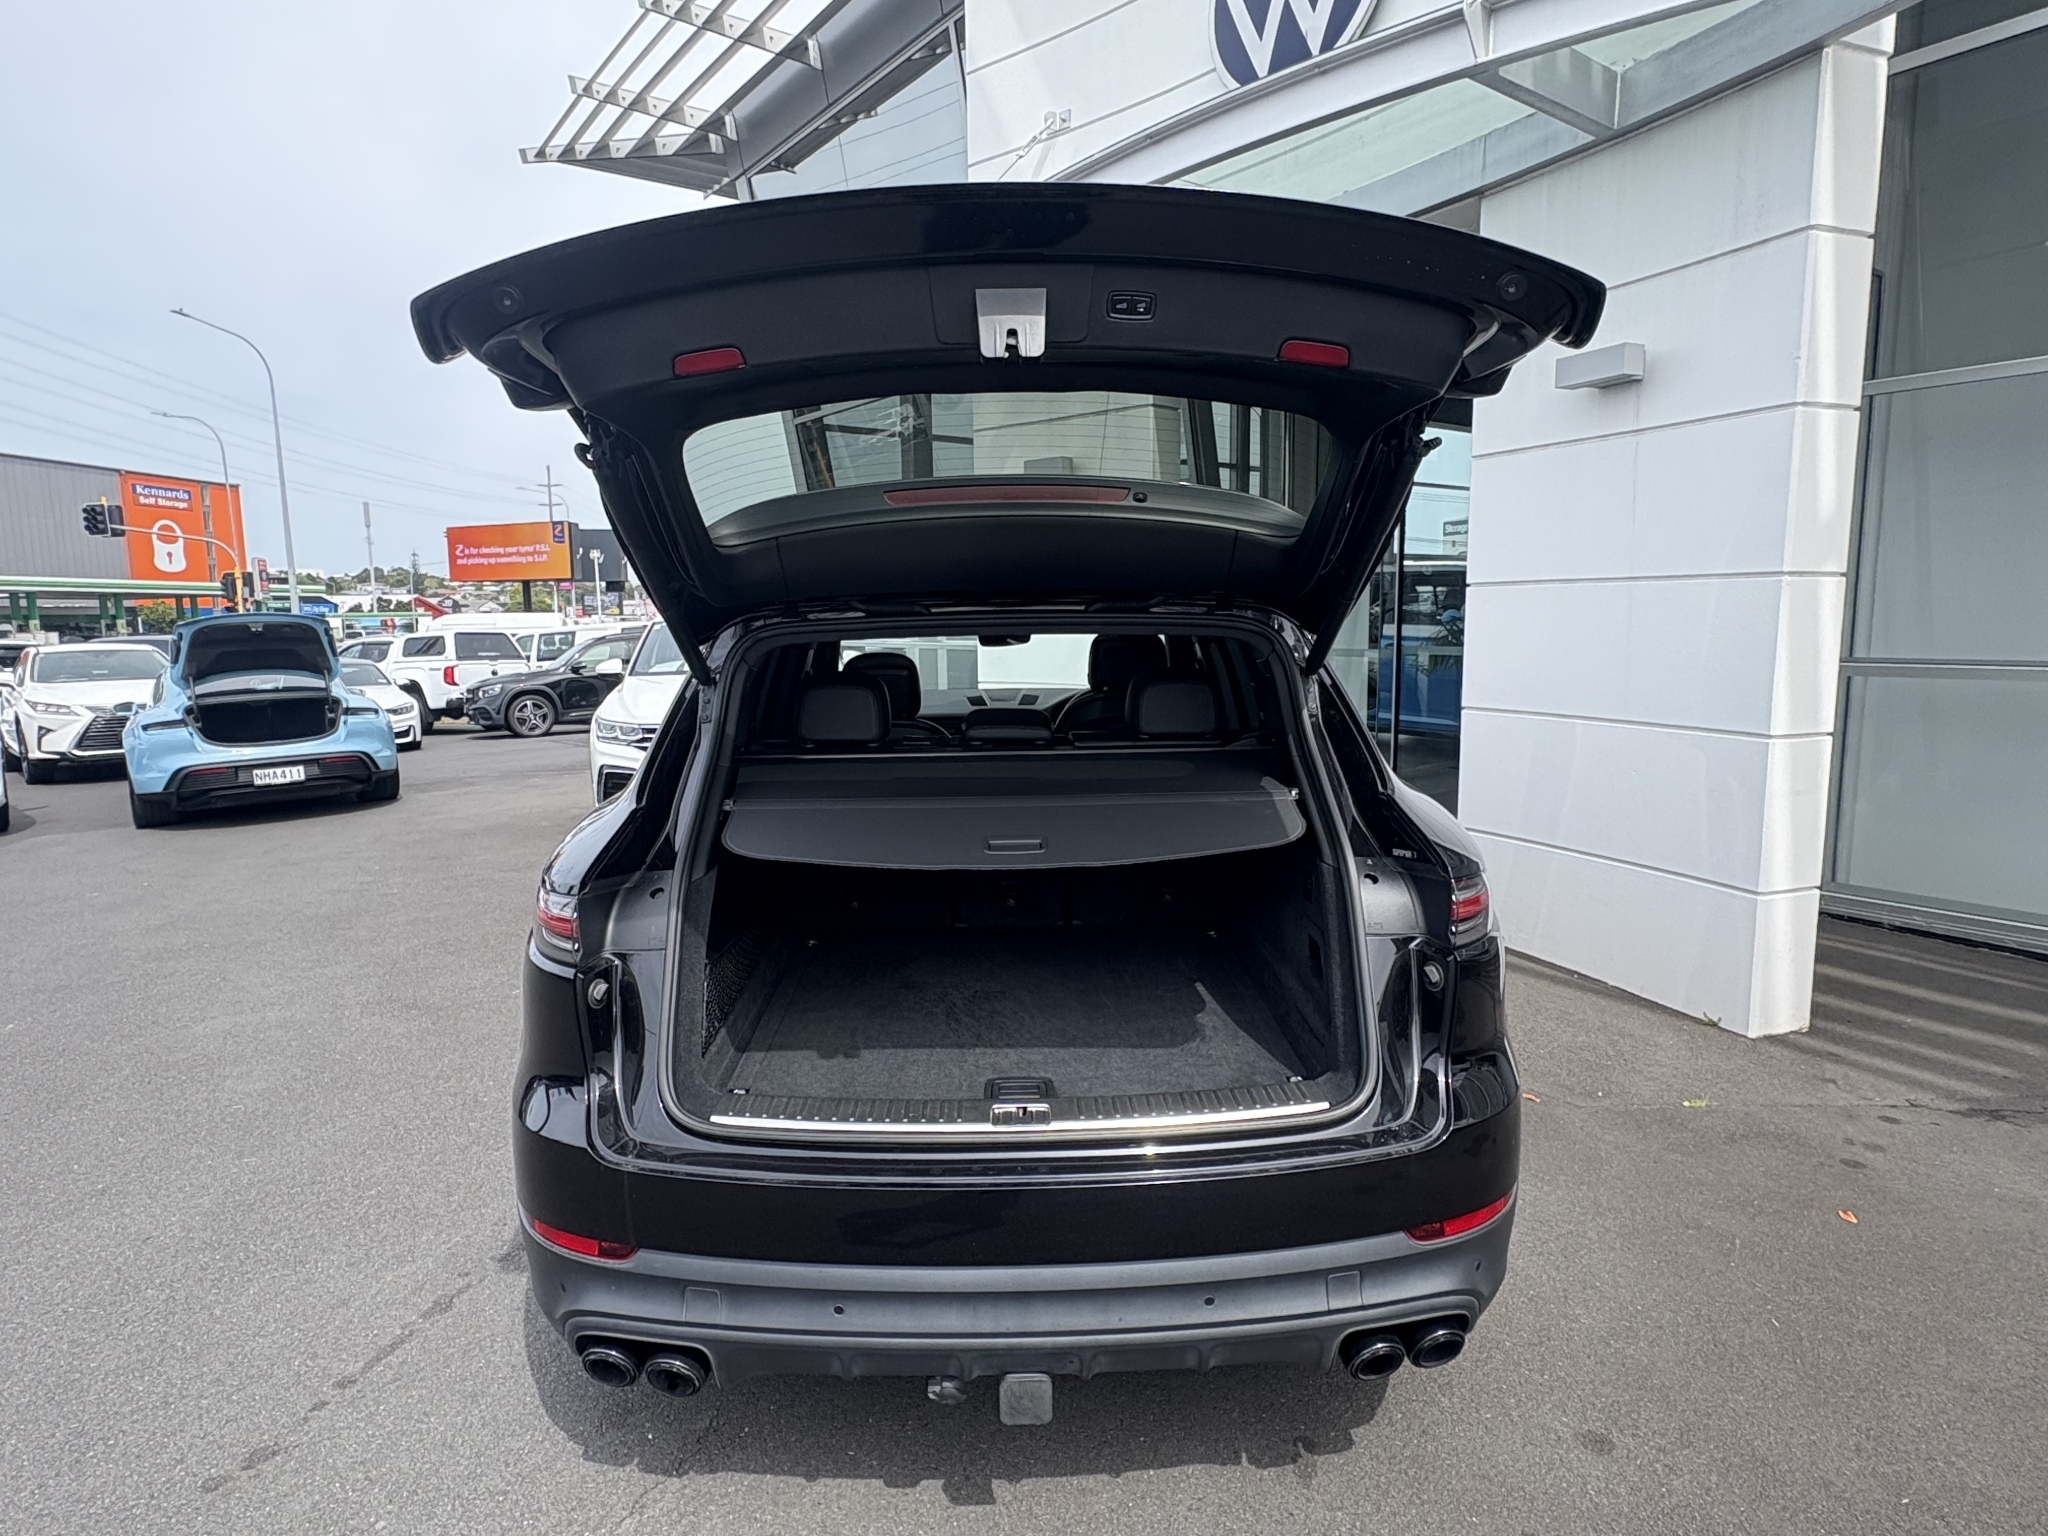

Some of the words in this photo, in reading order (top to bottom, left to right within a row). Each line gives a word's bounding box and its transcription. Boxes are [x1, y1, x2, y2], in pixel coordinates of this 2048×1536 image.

[135, 485, 189, 499] Kennards
[139, 495, 156, 505] Self
[157, 498, 188, 509] Storage
[455, 544, 464, 556] Z
[470, 546, 478, 554] for
[456, 556, 467, 565] and
[254, 768, 302, 783] NHA411
